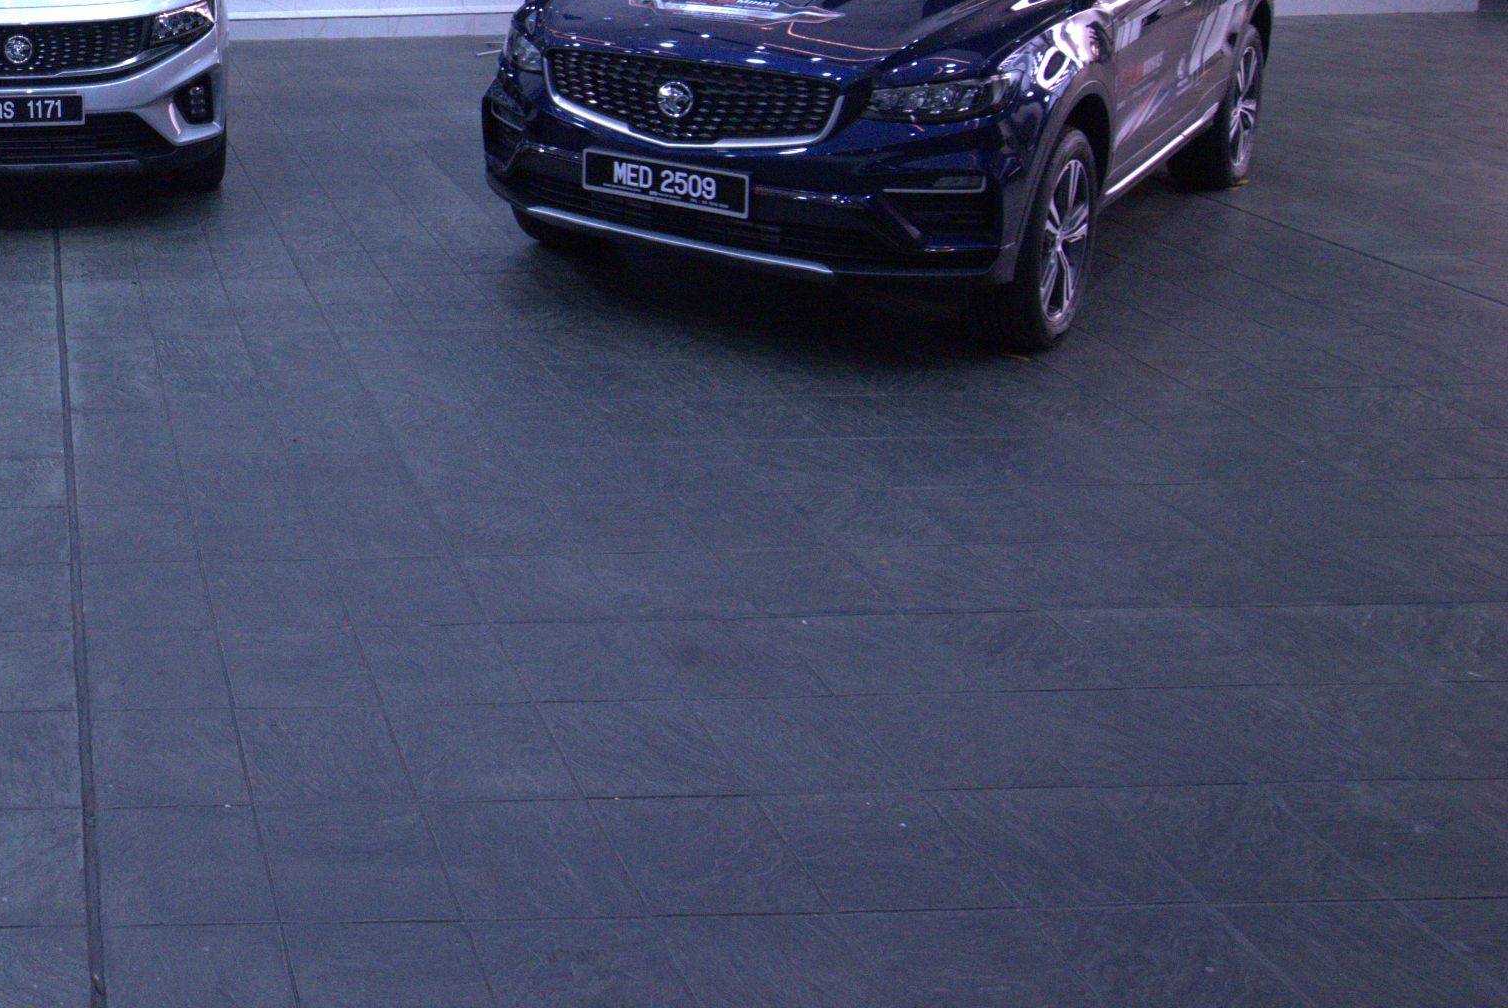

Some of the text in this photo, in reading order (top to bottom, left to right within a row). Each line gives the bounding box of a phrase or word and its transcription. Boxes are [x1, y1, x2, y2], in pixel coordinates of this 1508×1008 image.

[27, 99, 61, 119] 1171
[614, 161, 652, 188] MED
[661, 170, 716, 200] 2509
